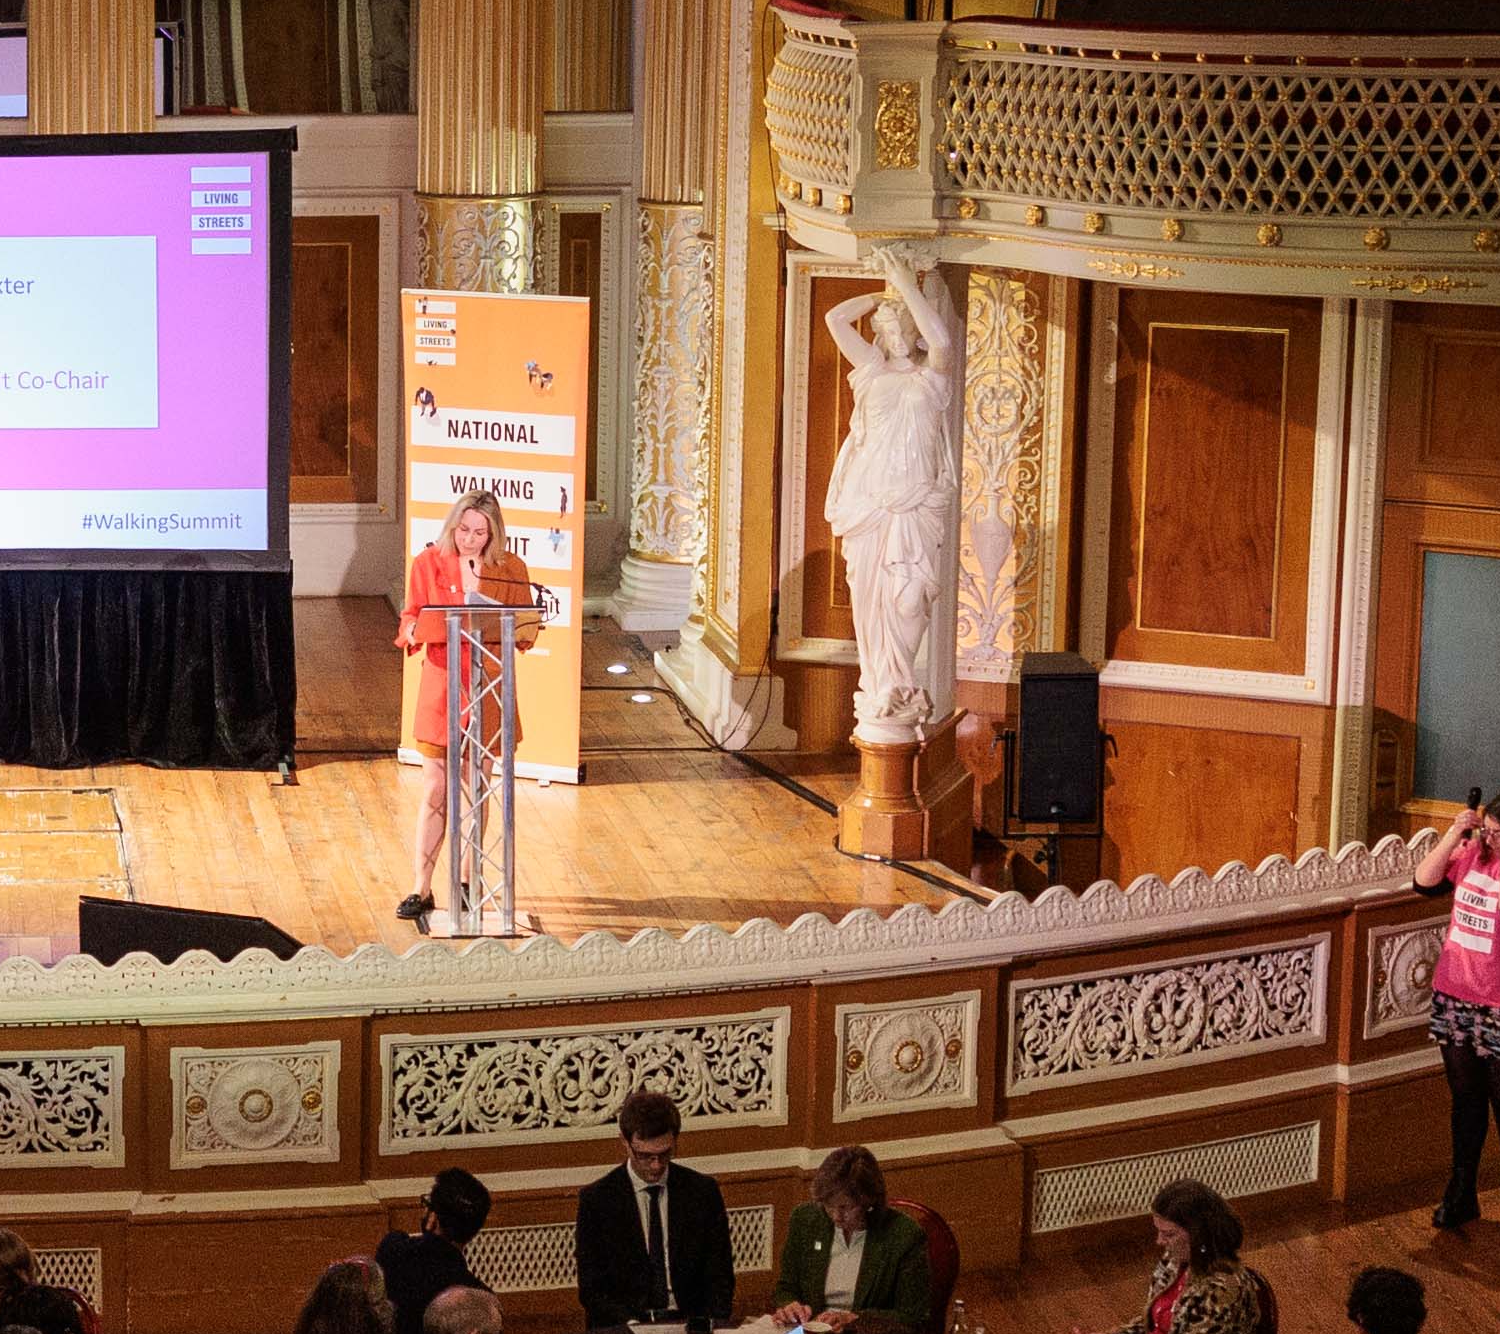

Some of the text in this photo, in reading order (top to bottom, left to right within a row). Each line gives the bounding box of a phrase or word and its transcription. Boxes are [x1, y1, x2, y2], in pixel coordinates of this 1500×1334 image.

[204, 193, 239, 204] LIVING
[198, 217, 244, 228] STREETS
[423, 320, 448, 329] LIVING
[420, 337, 451, 346] STREETS
[17, 370, 110, 390] Co-Chair
[447, 419, 540, 445] NATIONAL
[82, 513, 243, 533] #WalkingSummit
[1455, 910, 1489, 930] TREETS
